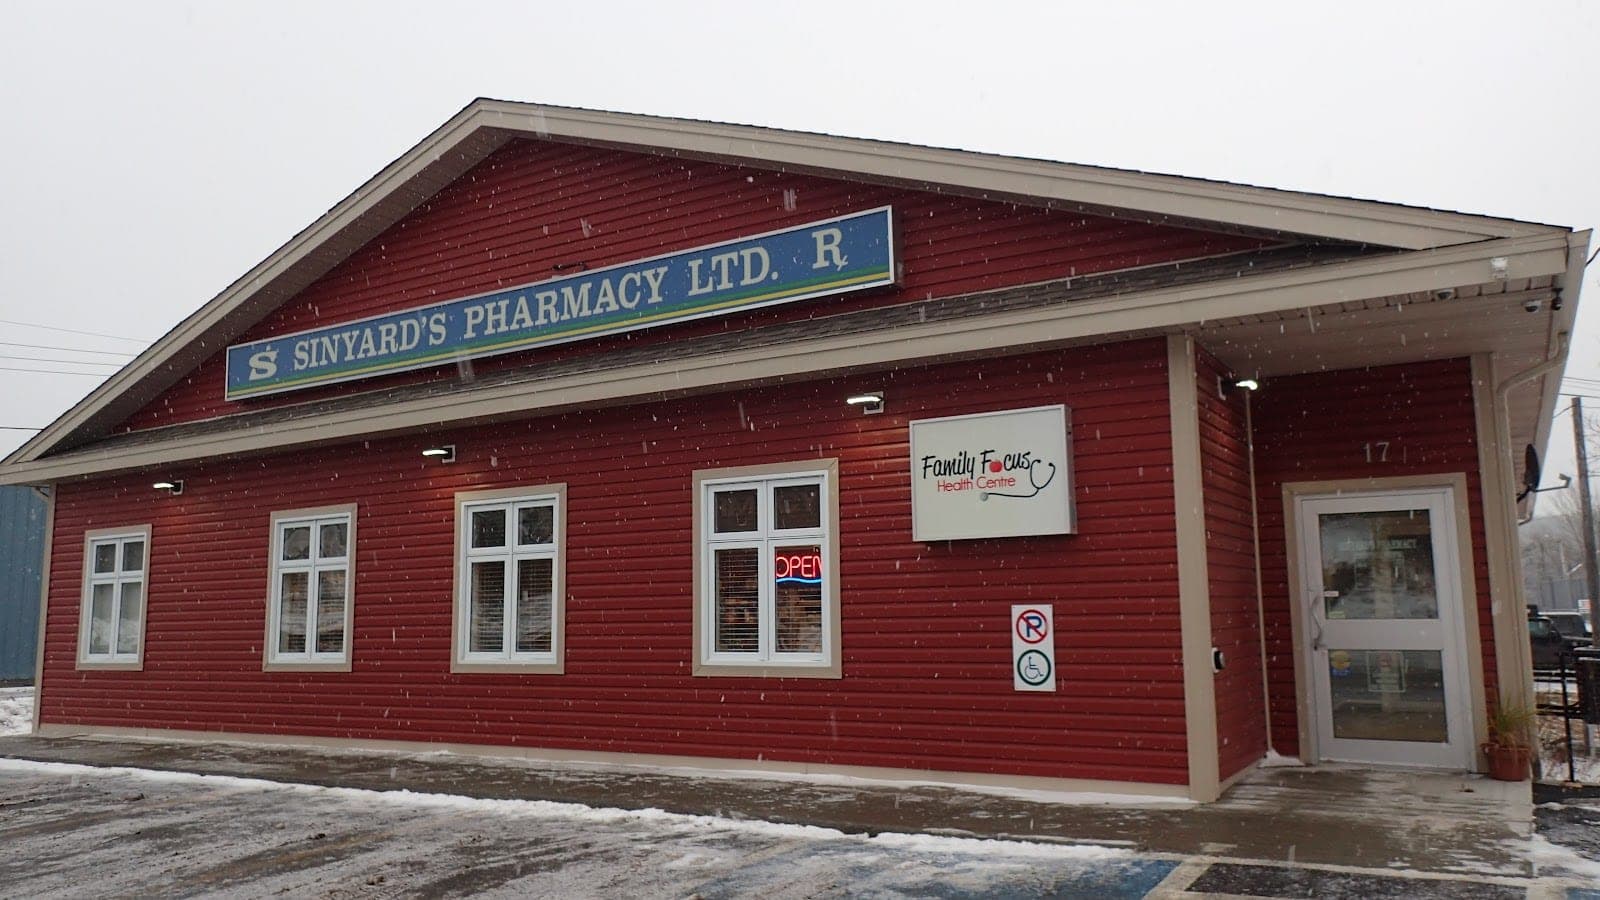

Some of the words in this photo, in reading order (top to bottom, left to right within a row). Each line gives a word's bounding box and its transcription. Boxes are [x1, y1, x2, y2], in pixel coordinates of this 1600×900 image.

[293, 312, 447, 371] SINYARD'S
[463, 266, 669, 340] PHARMACY
[688, 246, 779, 296] LTD.
[1363, 442, 1390, 463] 17
[921, 451, 976, 480] Family
[937, 479, 974, 493] Health
[976, 476, 1016, 489] Centre
[775, 555, 823, 578] OPEN
